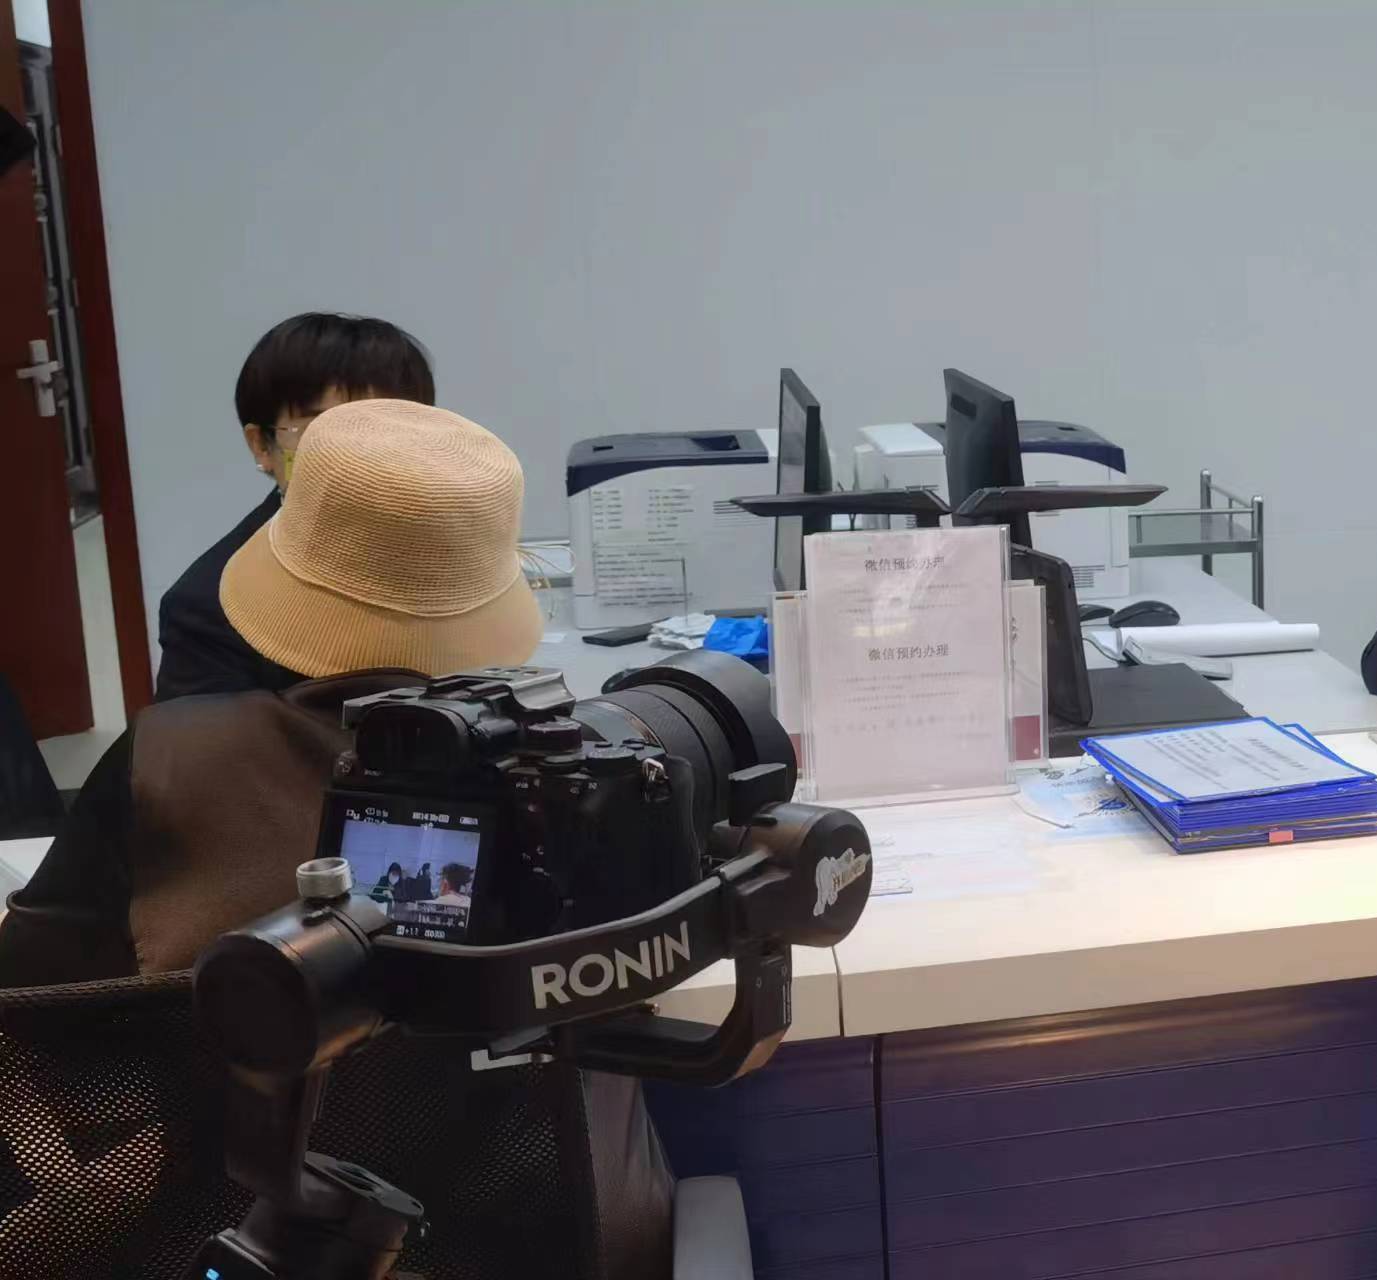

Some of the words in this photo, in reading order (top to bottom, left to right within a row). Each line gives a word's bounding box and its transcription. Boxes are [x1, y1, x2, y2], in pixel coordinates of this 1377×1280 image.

[867, 643, 950, 661] 微信预约办理
[531, 921, 690, 1009] RONIN
